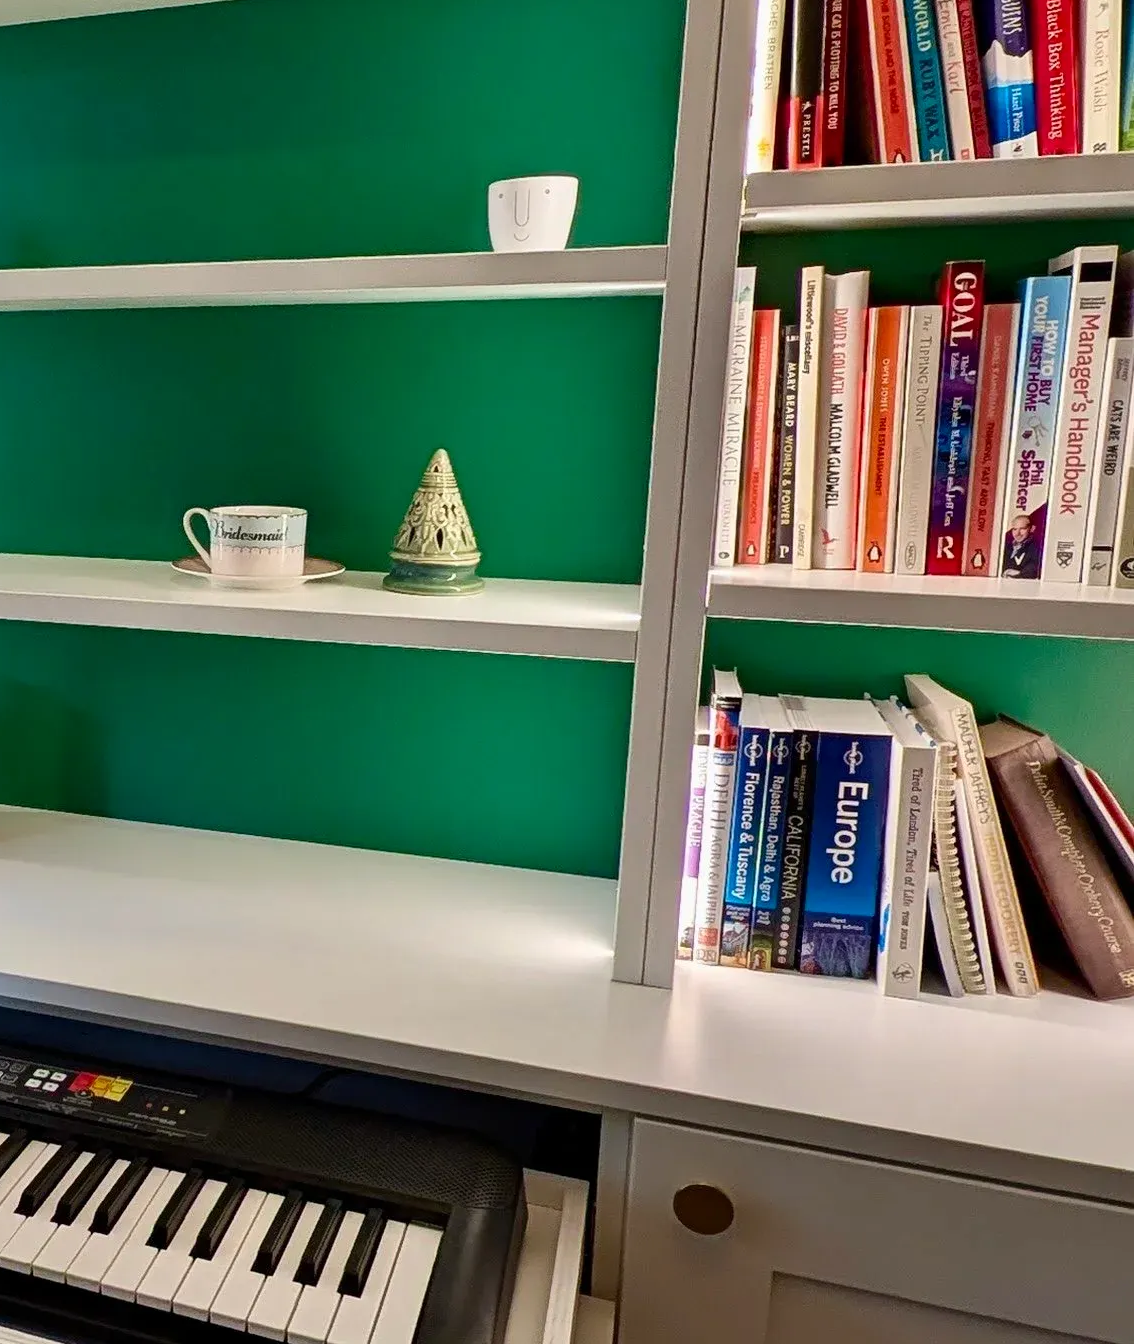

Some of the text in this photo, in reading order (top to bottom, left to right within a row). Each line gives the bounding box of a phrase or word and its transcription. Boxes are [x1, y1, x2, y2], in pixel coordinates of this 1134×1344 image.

[831, 14, 841, 28] CAT
[831, 30, 840, 38] IS
[1046, 0, 1062, 39] Black
[830, 40, 840, 78] PLOTTING
[919, 59, 936, 99] RUBY
[946, 61, 963, 94] Karl
[1048, 42, 1062, 70] Box
[1093, 29, 1109, 112] Rosie Walsh
[829, 80, 838, 91] TO
[829, 93, 838, 109] KILL
[1011, 87, 1022, 109] Hazel
[1048, 73, 1065, 139] Thinking
[802, 114, 810, 157] PRESTEL
[828, 112, 837, 129] YOU
[925, 106, 939, 140] WAX
[802, 280, 815, 373] Littlewood's miscellany
[946, 273, 976, 346] GOAL
[787, 362, 796, 390] MARY
[915, 314, 932, 422] The TIPPING POINT
[960, 355, 969, 376] Third
[1024, 296, 1047, 411] YOUR FIRST HOME
[1038, 320, 1058, 404] HOW TO BUY
[1070, 315, 1099, 411] Manager's
[723, 325, 745, 485] MIGRAINE MIRACLE
[785, 395, 795, 426] BEARD
[824, 305, 849, 508] DAVID GOLIATH MALCOLM GLADWELL
[875, 358, 890, 494] OWEN JONES THE ESTABLISHMENT
[783, 435, 793, 475] WOMEN
[1104, 400, 1123, 475] CATS ARE WEIRD
[1016, 450, 1033, 510] Spencer
[1030, 460, 1044, 485] Phil
[1061, 418, 1088, 513] Handbook
[780, 490, 791, 524] POWER
[977, 466, 990, 531] FAST AND SLOW
[214, 519, 288, 543] Bridesmaid
[741, 773, 759, 829] Florence
[767, 776, 784, 831] Rajasthan,
[706, 773, 730, 924] DELHI AGRA & JAIPUR
[739, 832, 753, 843] &
[765, 835, 778, 862] Delhi
[828, 782, 868, 882] Europe
[957, 713, 1020, 953] MADHUR INDIAN COOKERY
[732, 847, 752, 898] Tuscany
[763, 864, 775, 873] &
[782, 816, 803, 899] CALIFORNIA
[899, 768, 923, 949] Tired of London, Tired of Life TOM JONES
[759, 876, 774, 901] Agra
[1077, 874, 1121, 953] Cookery Course
